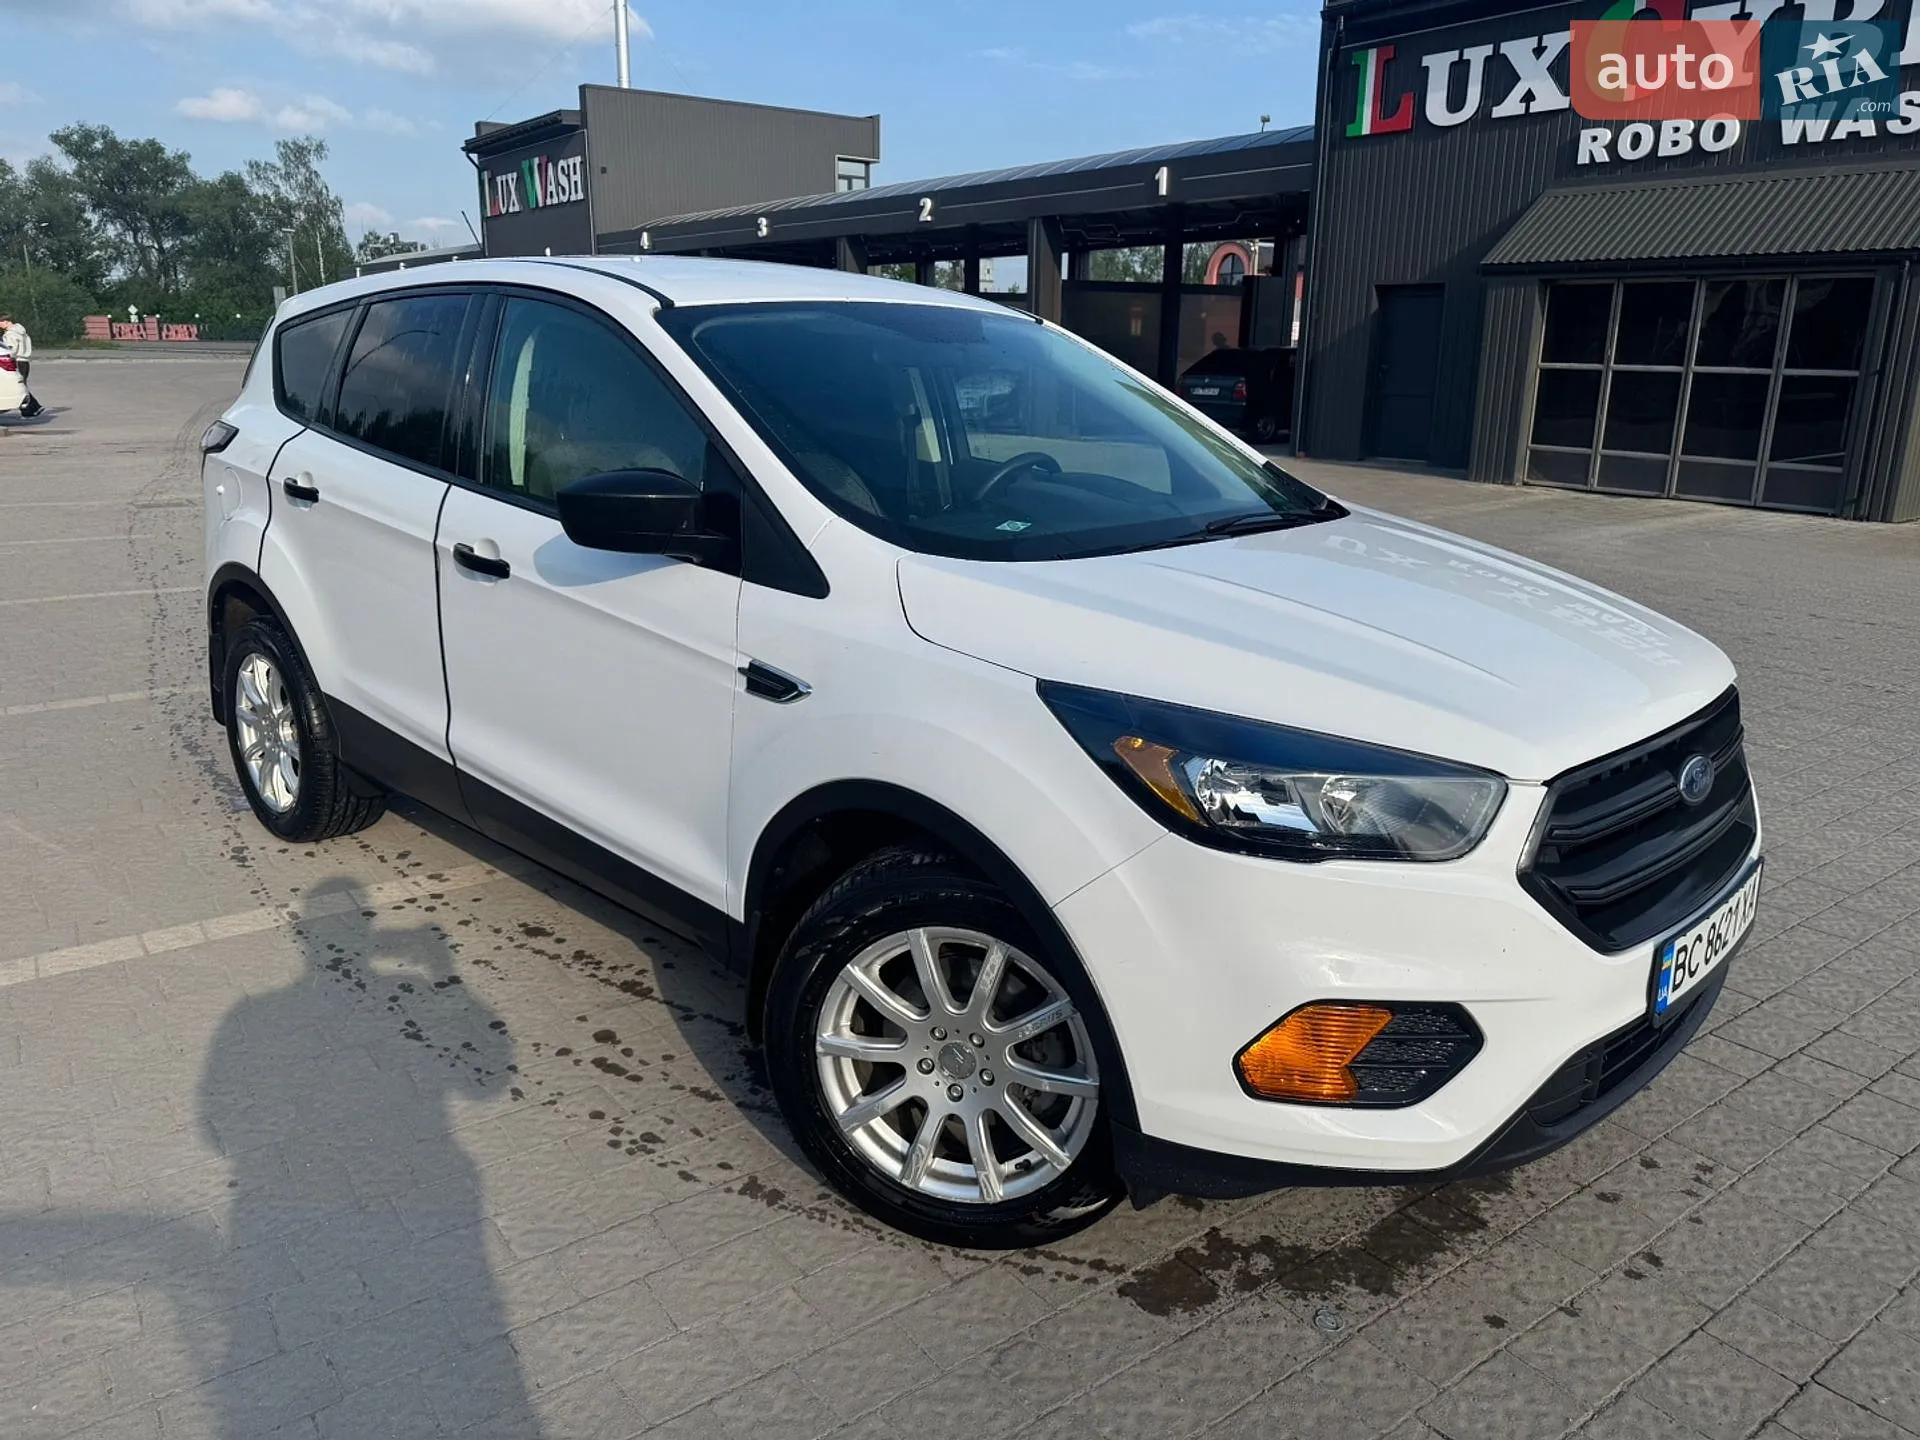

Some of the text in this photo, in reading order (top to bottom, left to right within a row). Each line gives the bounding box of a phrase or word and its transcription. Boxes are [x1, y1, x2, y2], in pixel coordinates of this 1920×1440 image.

[1346, 30, 1574, 137] LUX
[1577, 113, 1741, 165] ROBO
[481, 155, 584, 217] LUX WASH
[1154, 166, 1169, 196] 1
[757, 217, 768, 238] 3
[918, 198, 932, 222] 2
[639, 231, 650, 250] 4
[1672, 933, 1703, 993] BC
